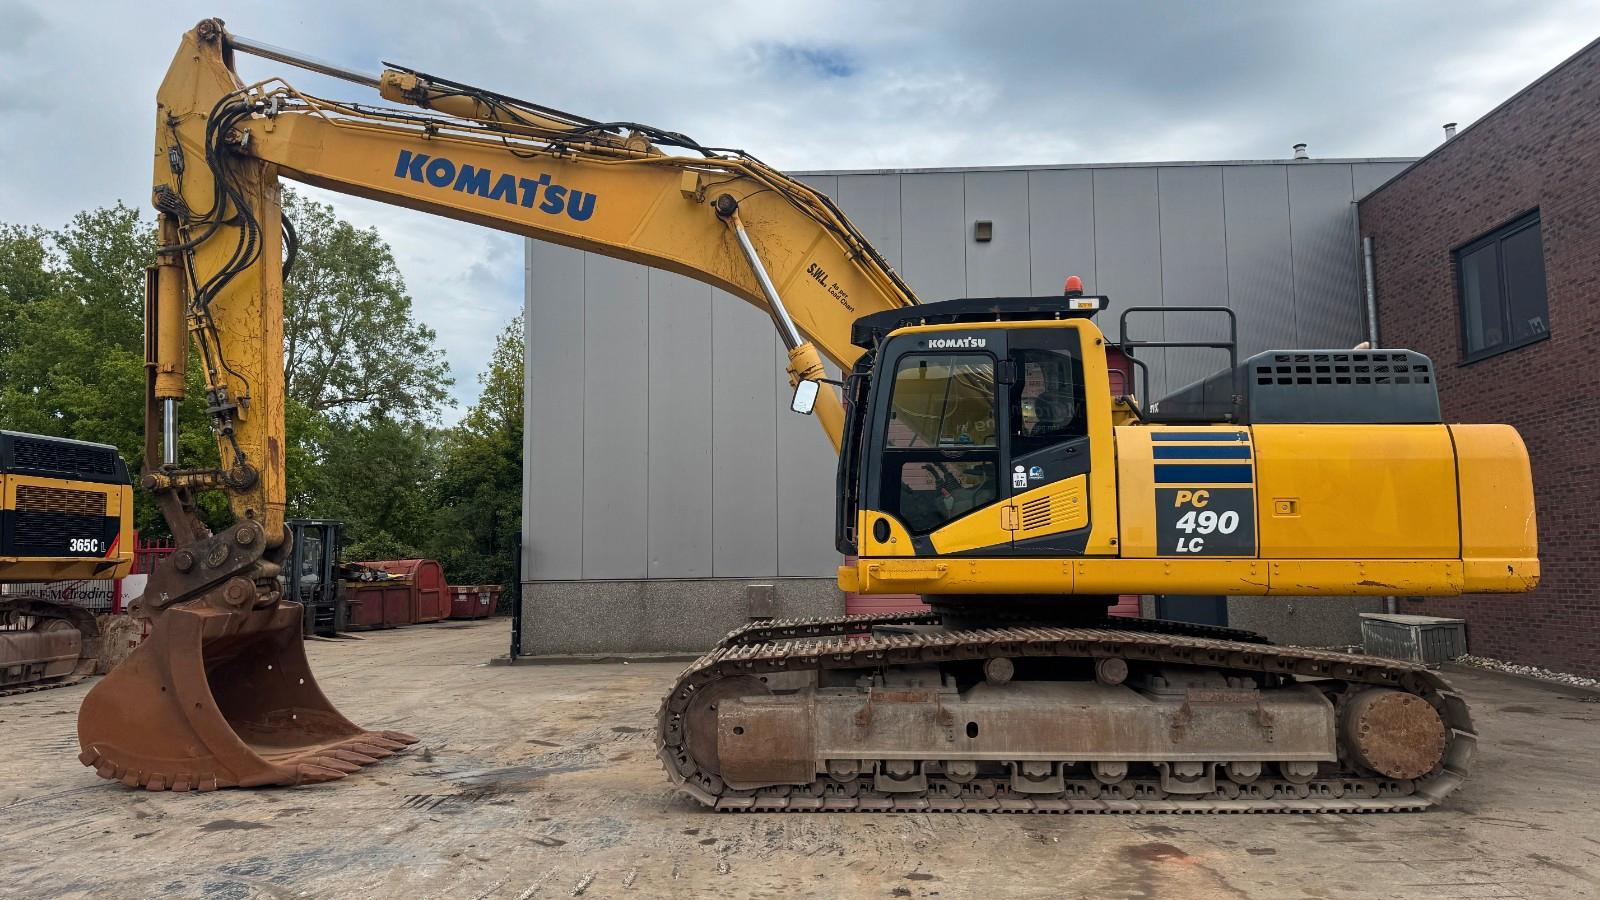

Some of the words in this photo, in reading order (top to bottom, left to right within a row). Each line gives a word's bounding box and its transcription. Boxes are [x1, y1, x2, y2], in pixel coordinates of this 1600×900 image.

[394, 149, 597, 222] KOMATSU
[832, 283, 840, 291] As
[838, 290, 848, 299] per
[828, 287, 842, 301] Load
[840, 298, 855, 313] Chart
[928, 336, 986, 349] KOMATSU
[1174, 490, 1210, 508] PC
[1176, 510, 1239, 534] 490
[70, 538, 98, 552] 365C
[100, 541, 107, 553] L
[1176, 537, 1204, 552] LC
